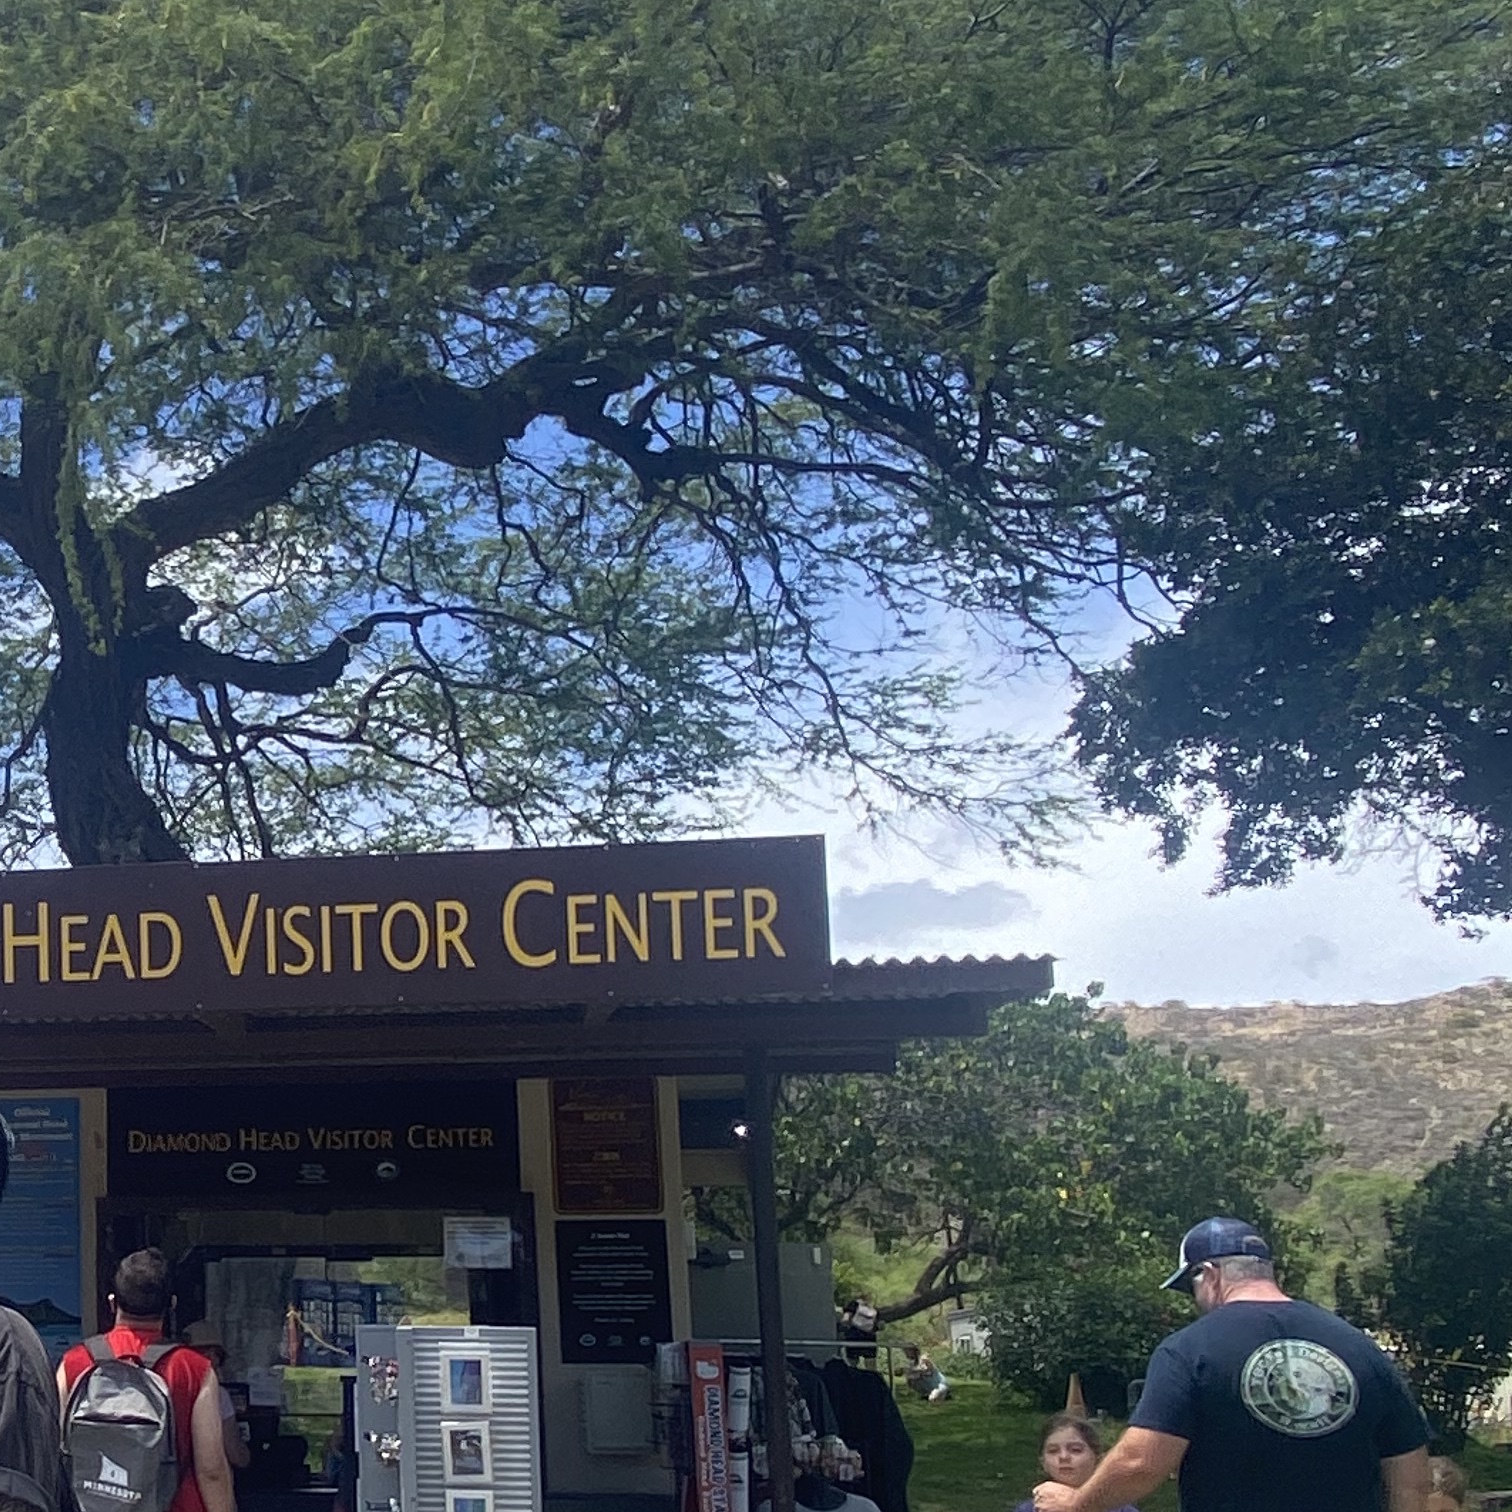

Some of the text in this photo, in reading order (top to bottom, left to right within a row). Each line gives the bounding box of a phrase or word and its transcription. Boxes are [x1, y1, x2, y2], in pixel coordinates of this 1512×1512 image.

[1, 901, 183, 984] HEAD
[207, 891, 475, 975] VISITOR
[501, 878, 787, 968] CENTER
[128, 1125, 494, 1153] DIAMOND HEAD VISITOR CENTER
[710, 1450, 726, 1484] HEAD
[83, 1480, 142, 1500] MINNESOTA
